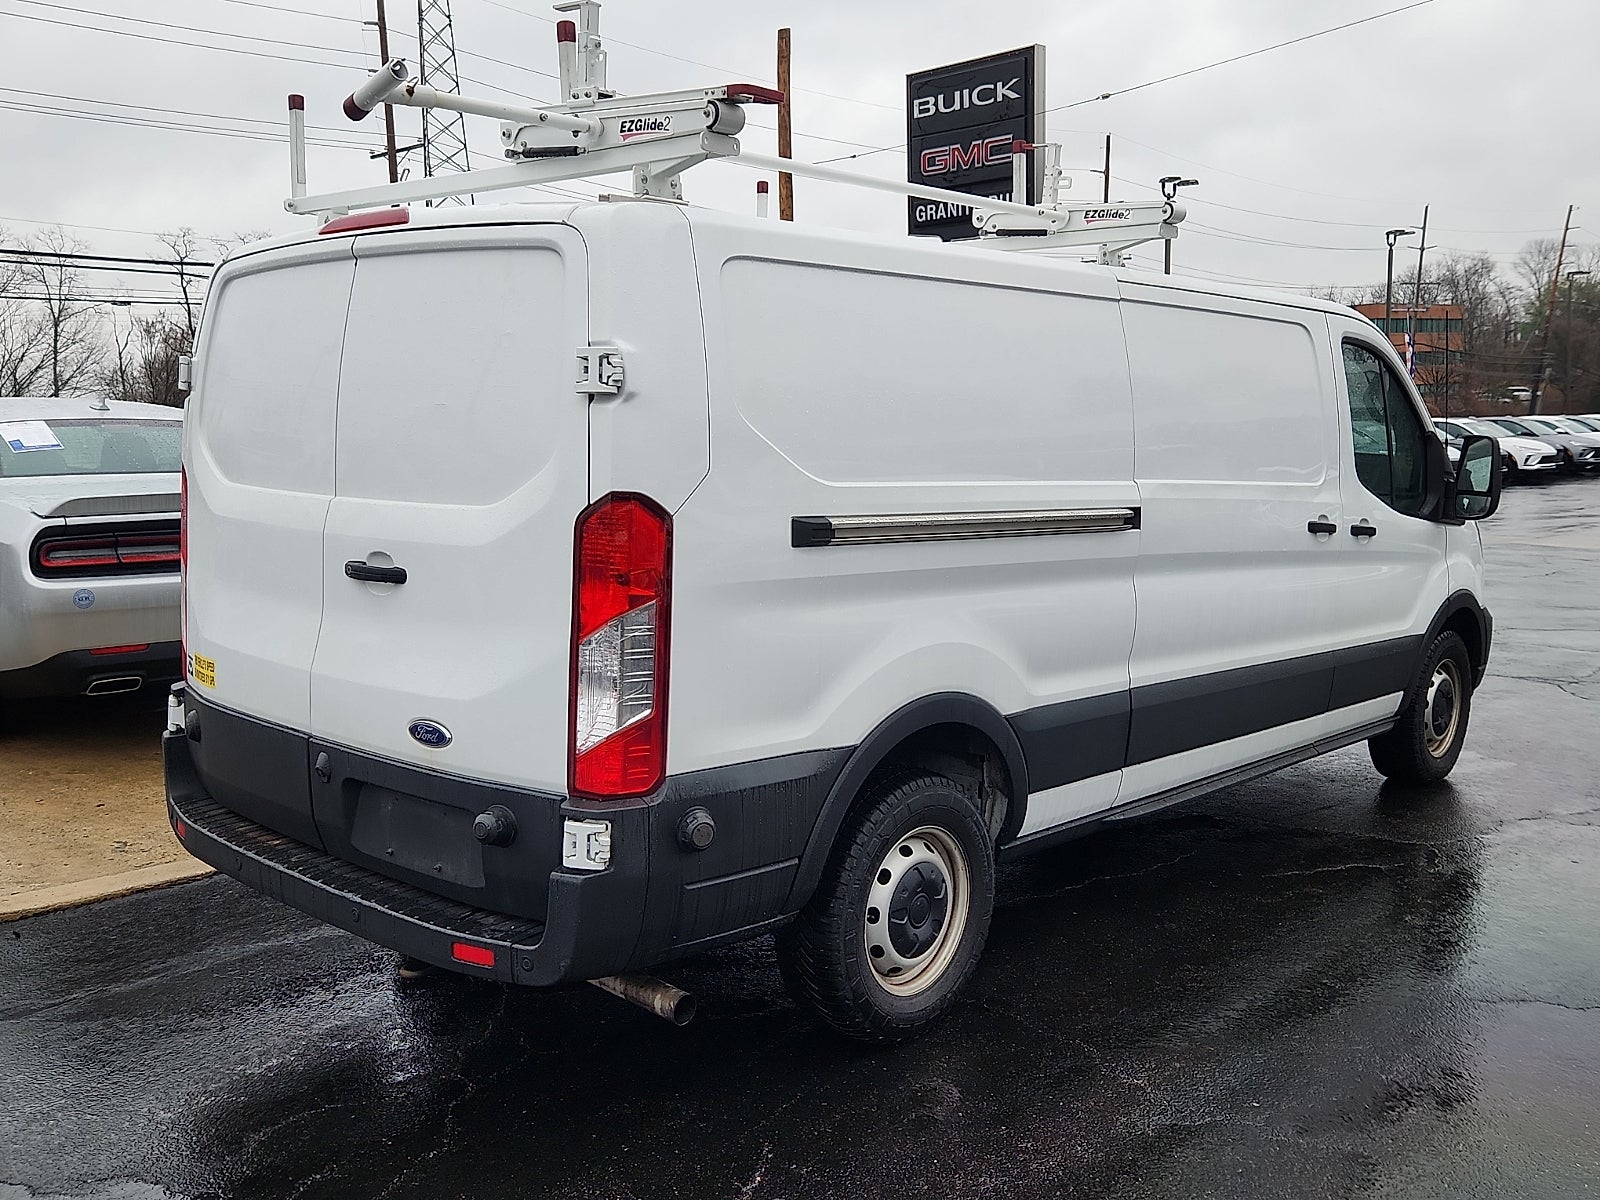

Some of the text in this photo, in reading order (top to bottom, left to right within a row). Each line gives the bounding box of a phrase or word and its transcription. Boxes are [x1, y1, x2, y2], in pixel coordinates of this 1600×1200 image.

[913, 77, 1022, 119] BUICK
[620, 115, 671, 133] EZGlide2
[921, 134, 1013, 176] GMC
[1083, 208, 1131, 219] EZGlide2
[415, 724, 439, 742] Ford
